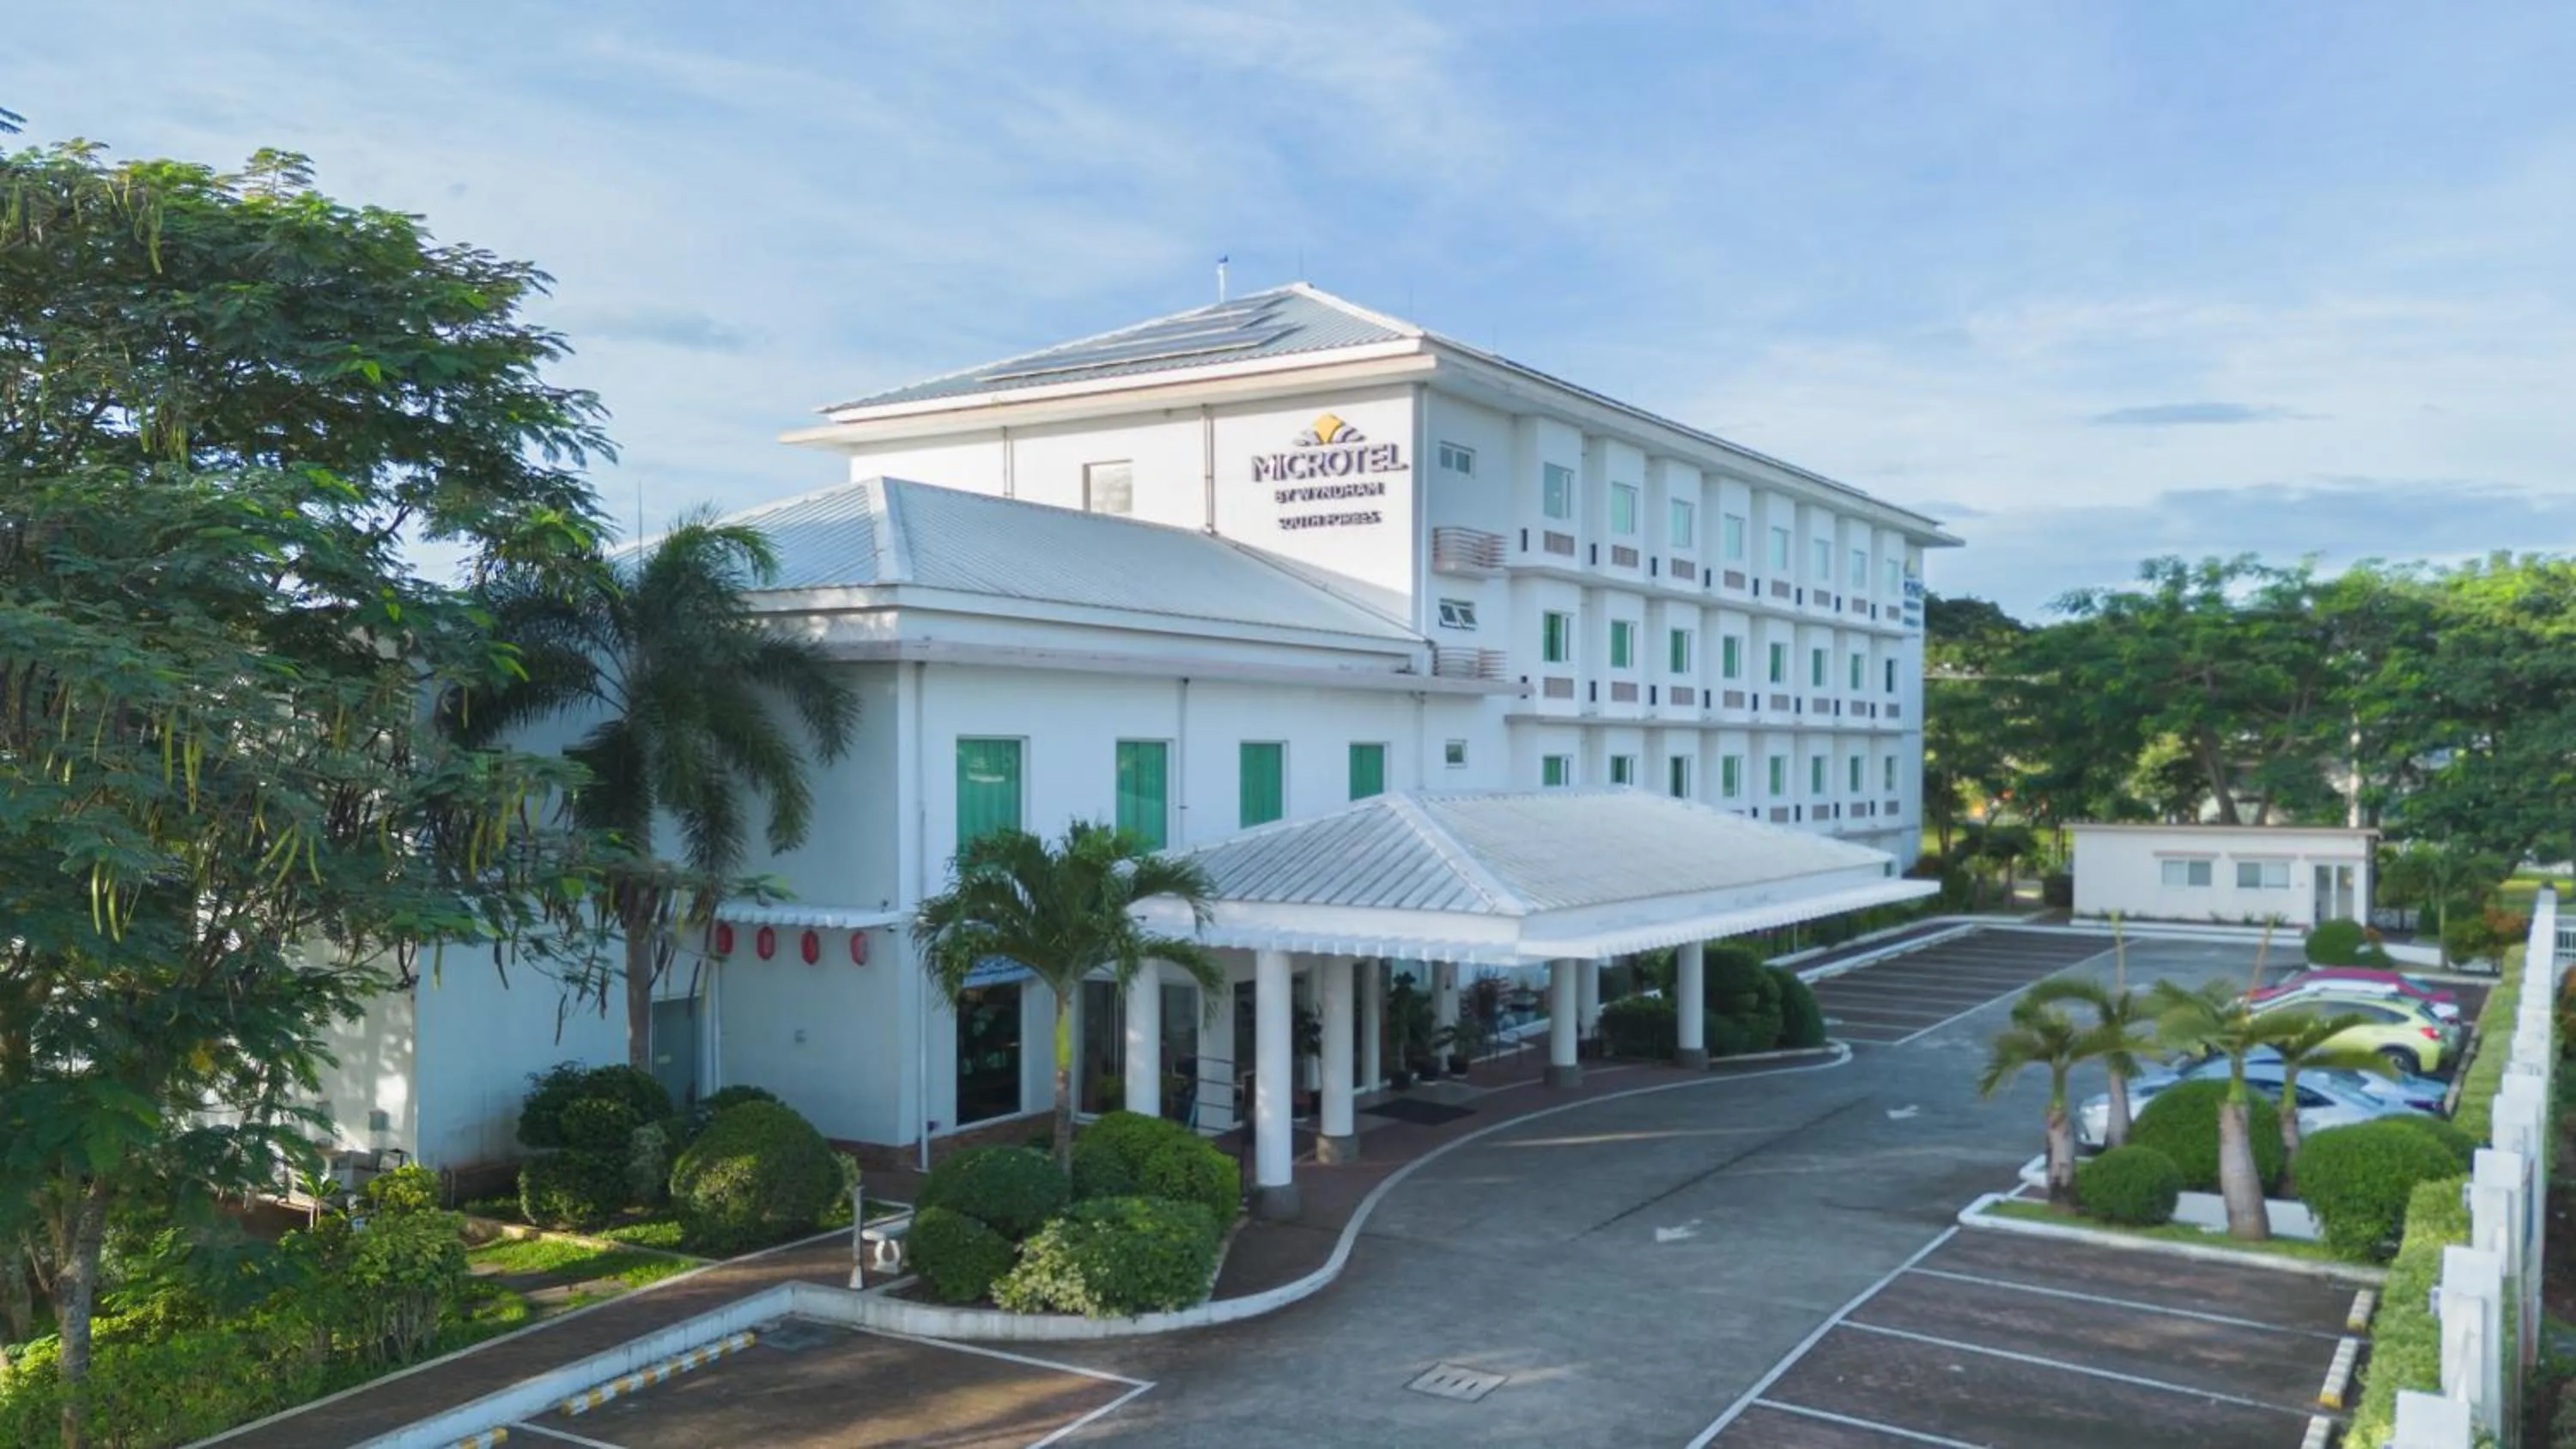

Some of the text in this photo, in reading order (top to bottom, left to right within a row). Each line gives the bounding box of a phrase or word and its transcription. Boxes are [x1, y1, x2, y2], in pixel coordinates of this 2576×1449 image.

[1251, 443, 1410, 482] MICROTEL
[1275, 482, 1385, 504] BY WYNDHAM
